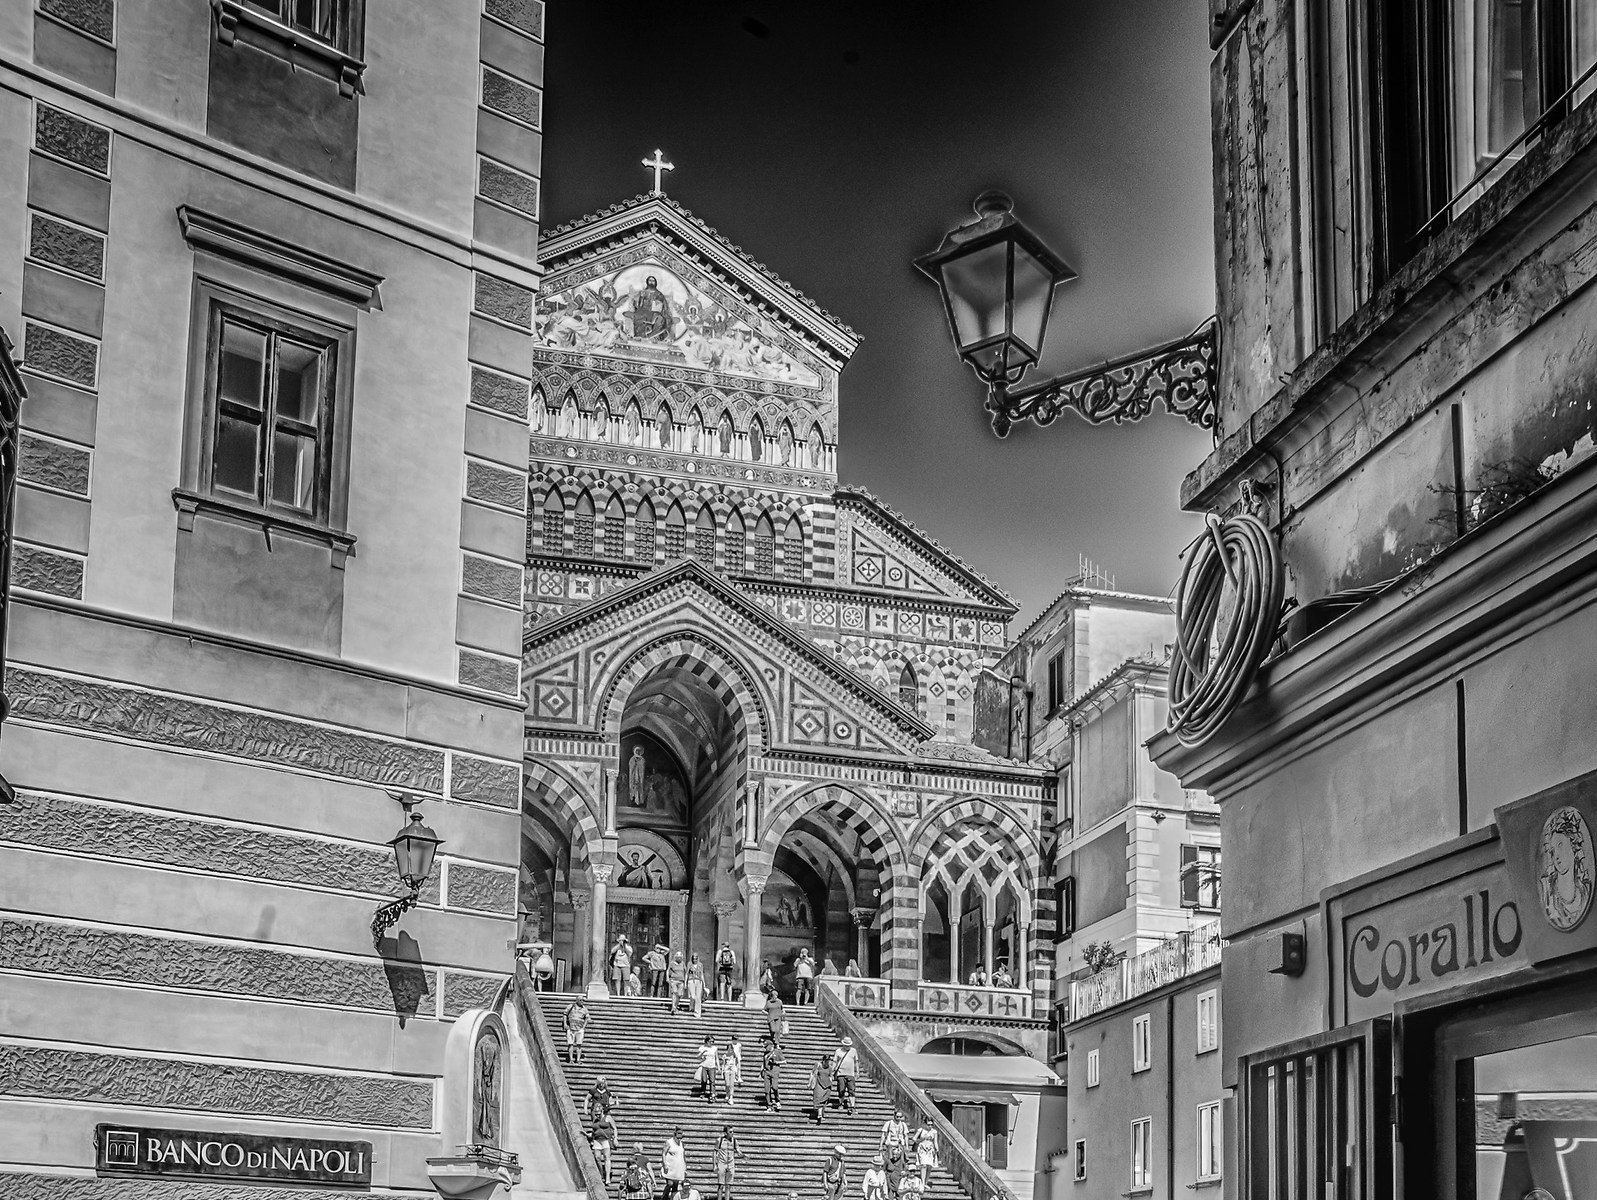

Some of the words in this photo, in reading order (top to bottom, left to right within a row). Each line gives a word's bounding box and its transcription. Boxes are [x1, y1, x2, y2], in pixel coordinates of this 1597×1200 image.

[1350, 889, 1523, 998] Corallo
[146, 1137, 245, 1167] BANCO
[247, 1151, 268, 1169] DI
[271, 1146, 364, 1175] NAPOLI
